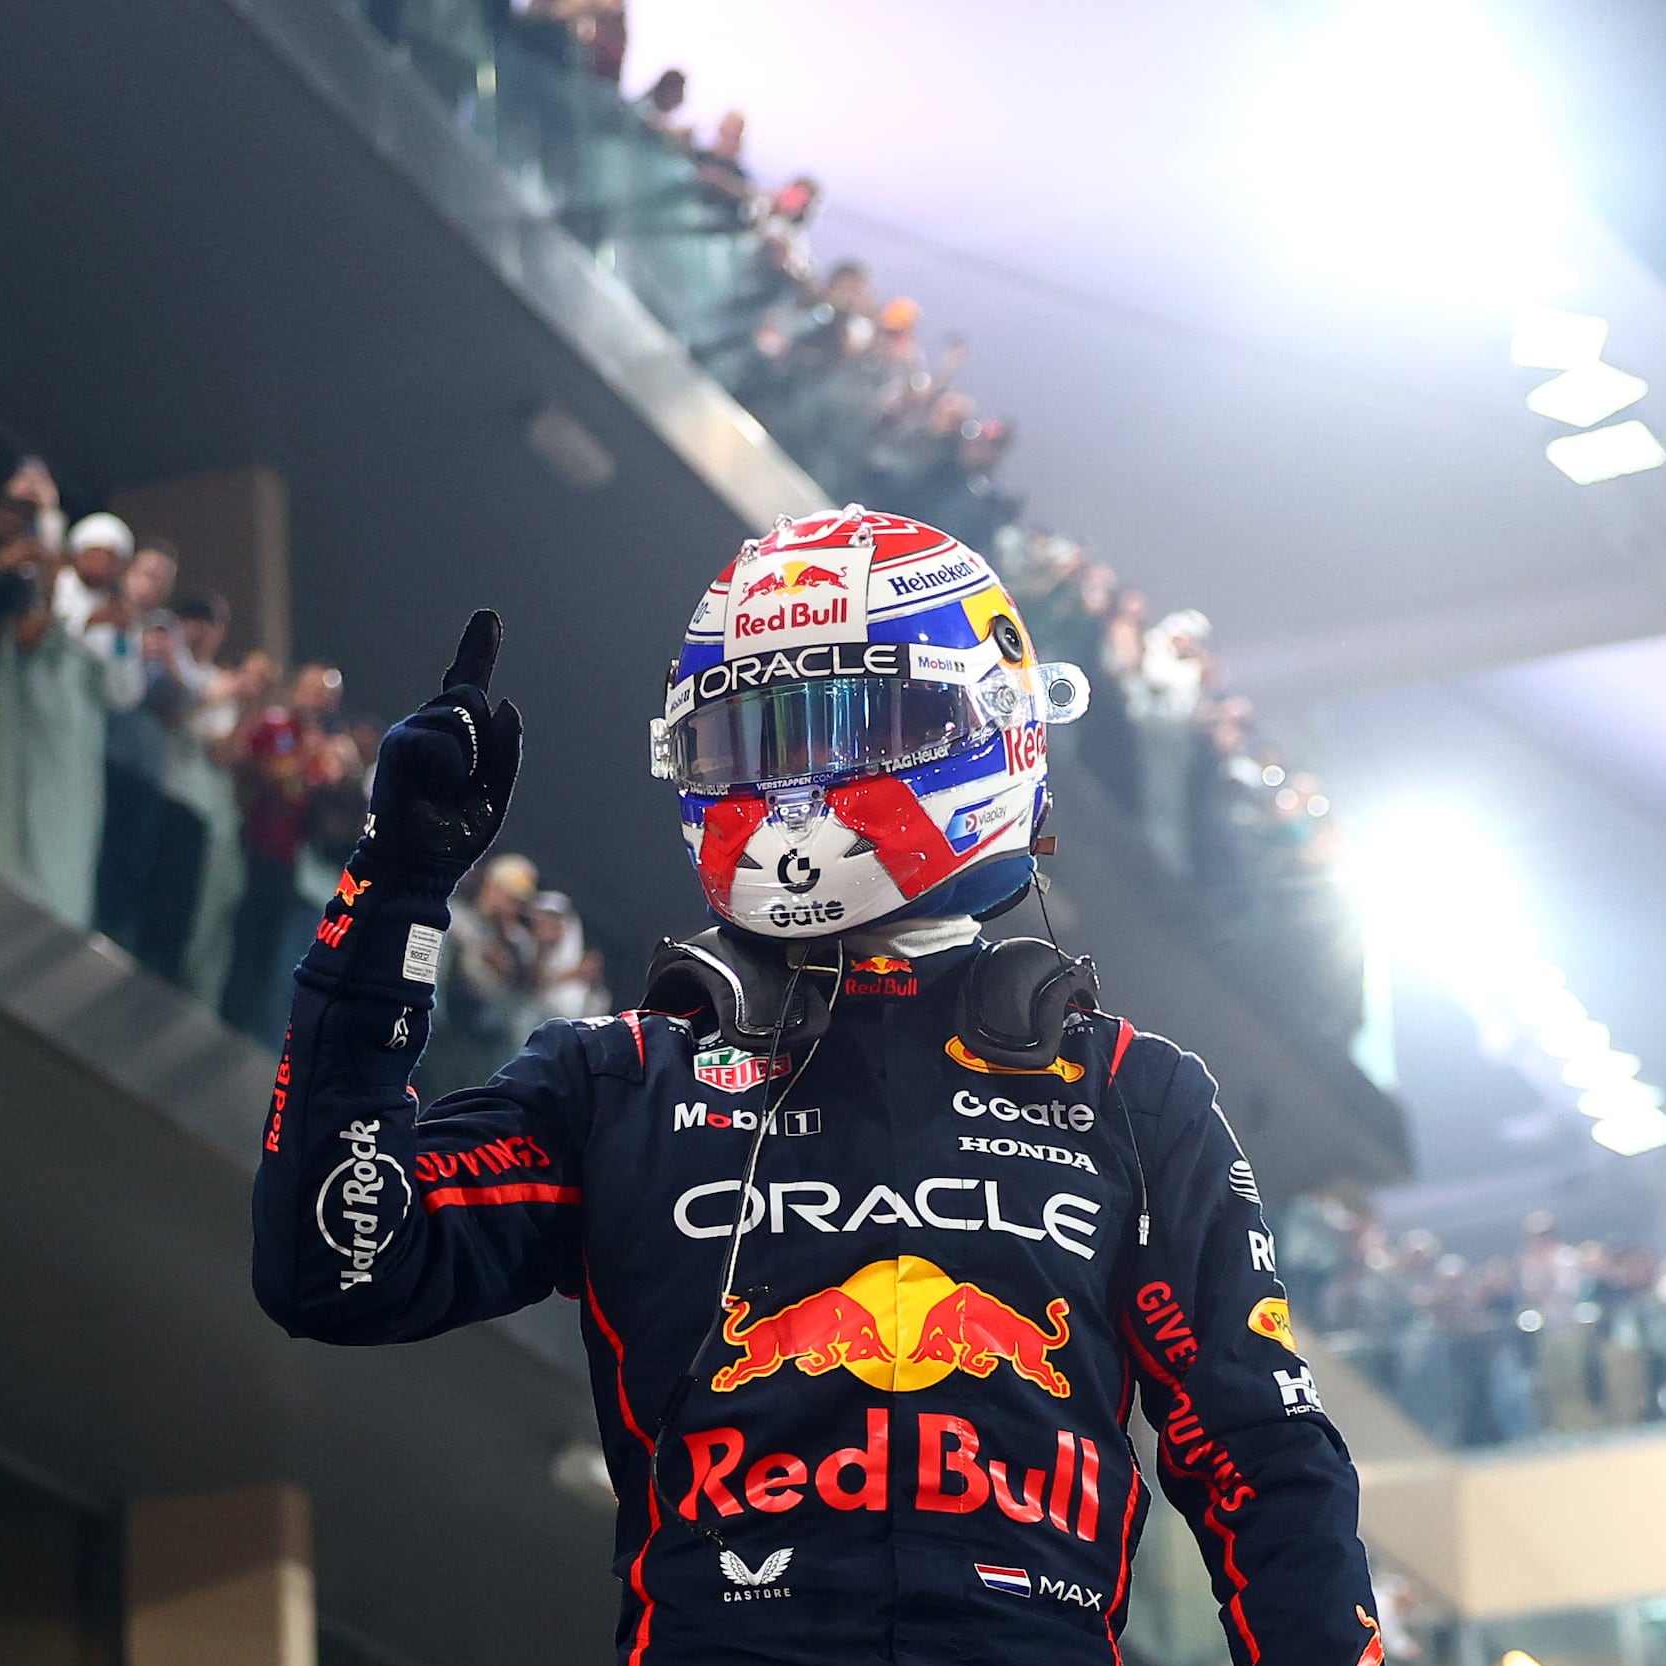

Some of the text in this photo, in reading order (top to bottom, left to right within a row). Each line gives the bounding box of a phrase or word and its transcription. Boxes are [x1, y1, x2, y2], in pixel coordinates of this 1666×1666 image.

[888, 561, 973, 596] Heineken
[735, 604, 785, 639] Red
[791, 598, 848, 628] Bull
[699, 644, 899, 699] ORACLE
[918, 656, 953, 671] Mobil
[756, 773, 833, 791] VERSTAPPEN.COM
[978, 805, 1007, 825] viaplay
[770, 900, 845, 928] Gate
[845, 977, 919, 996] Red Bull
[673, 1102, 778, 1135] Mobil
[989, 1098, 1096, 1132] Gate
[340, 1119, 385, 1206] Rock
[958, 1136, 1099, 1175] HONDA
[674, 1179, 1101, 1260] ORACLE
[678, 1408, 1103, 1543] Red Bull
[723, 1587, 792, 1602] CASTORE
[1038, 1575, 1103, 1612] MAX
